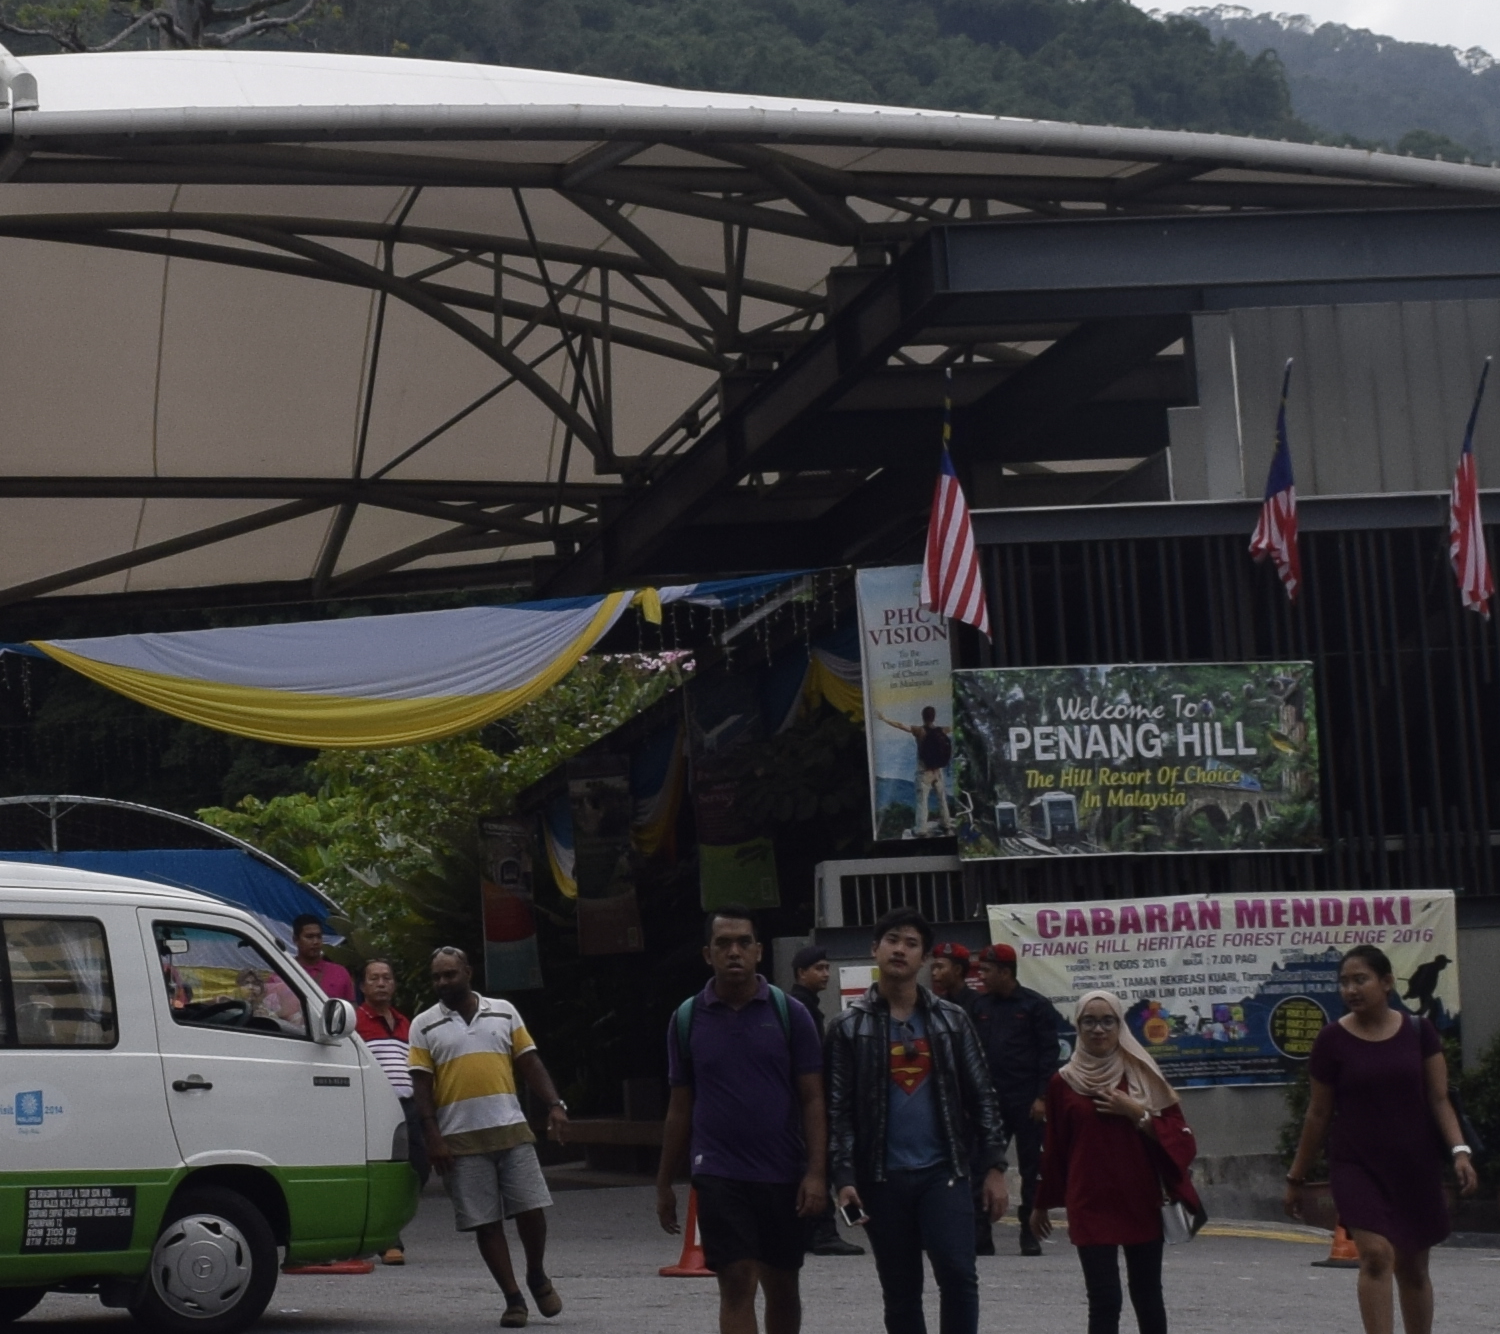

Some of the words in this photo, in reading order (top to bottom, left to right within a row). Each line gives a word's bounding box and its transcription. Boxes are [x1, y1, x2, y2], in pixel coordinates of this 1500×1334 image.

[883, 607, 931, 626] PHC
[868, 624, 948, 646] VISION
[1056, 695, 1166, 720] Welcome
[1170, 693, 1198, 719] To
[1008, 723, 1164, 762] PENANG
[1176, 721, 1258, 757] HILL
[1025, 769, 1055, 788] The
[1059, 768, 1093, 788] Hill
[1098, 766, 1152, 786] Resort
[1156, 765, 1180, 786] Of
[1184, 765, 1242, 785] Choice
[1083, 789, 1102, 808] In
[1106, 787, 1187, 811] Malaysia
[1035, 900, 1222, 939] CABARAN
[1234, 896, 1413, 930] MENDAKI
[1021, 940, 1089, 958] PENANG
[1095, 939, 1131, 954] HILL
[1137, 934, 1217, 953] HERITAGE
[1222, 931, 1286, 948] FOREST
[1290, 930, 1387, 947] CHALLENGE
[1392, 928, 1434, 944] 2016
[1098, 960, 1109, 971] 21
[1113, 959, 1140, 970] OGOS
[1142, 957, 1167, 969] 2016
[1212, 954, 1233, 965] 7.00
[1235, 953, 1257, 964] PAGI
[1122, 977, 1157, 989] TAMAN
[1160, 974, 1206, 986] REKREASI
[1131, 988, 1157, 999] TUAN
[1158, 987, 1176, 998] LIM
[1178, 986, 1206, 998] GUAN
[1208, 985, 1227, 996] ENG
[44, 1105, 64, 1115] 2014
